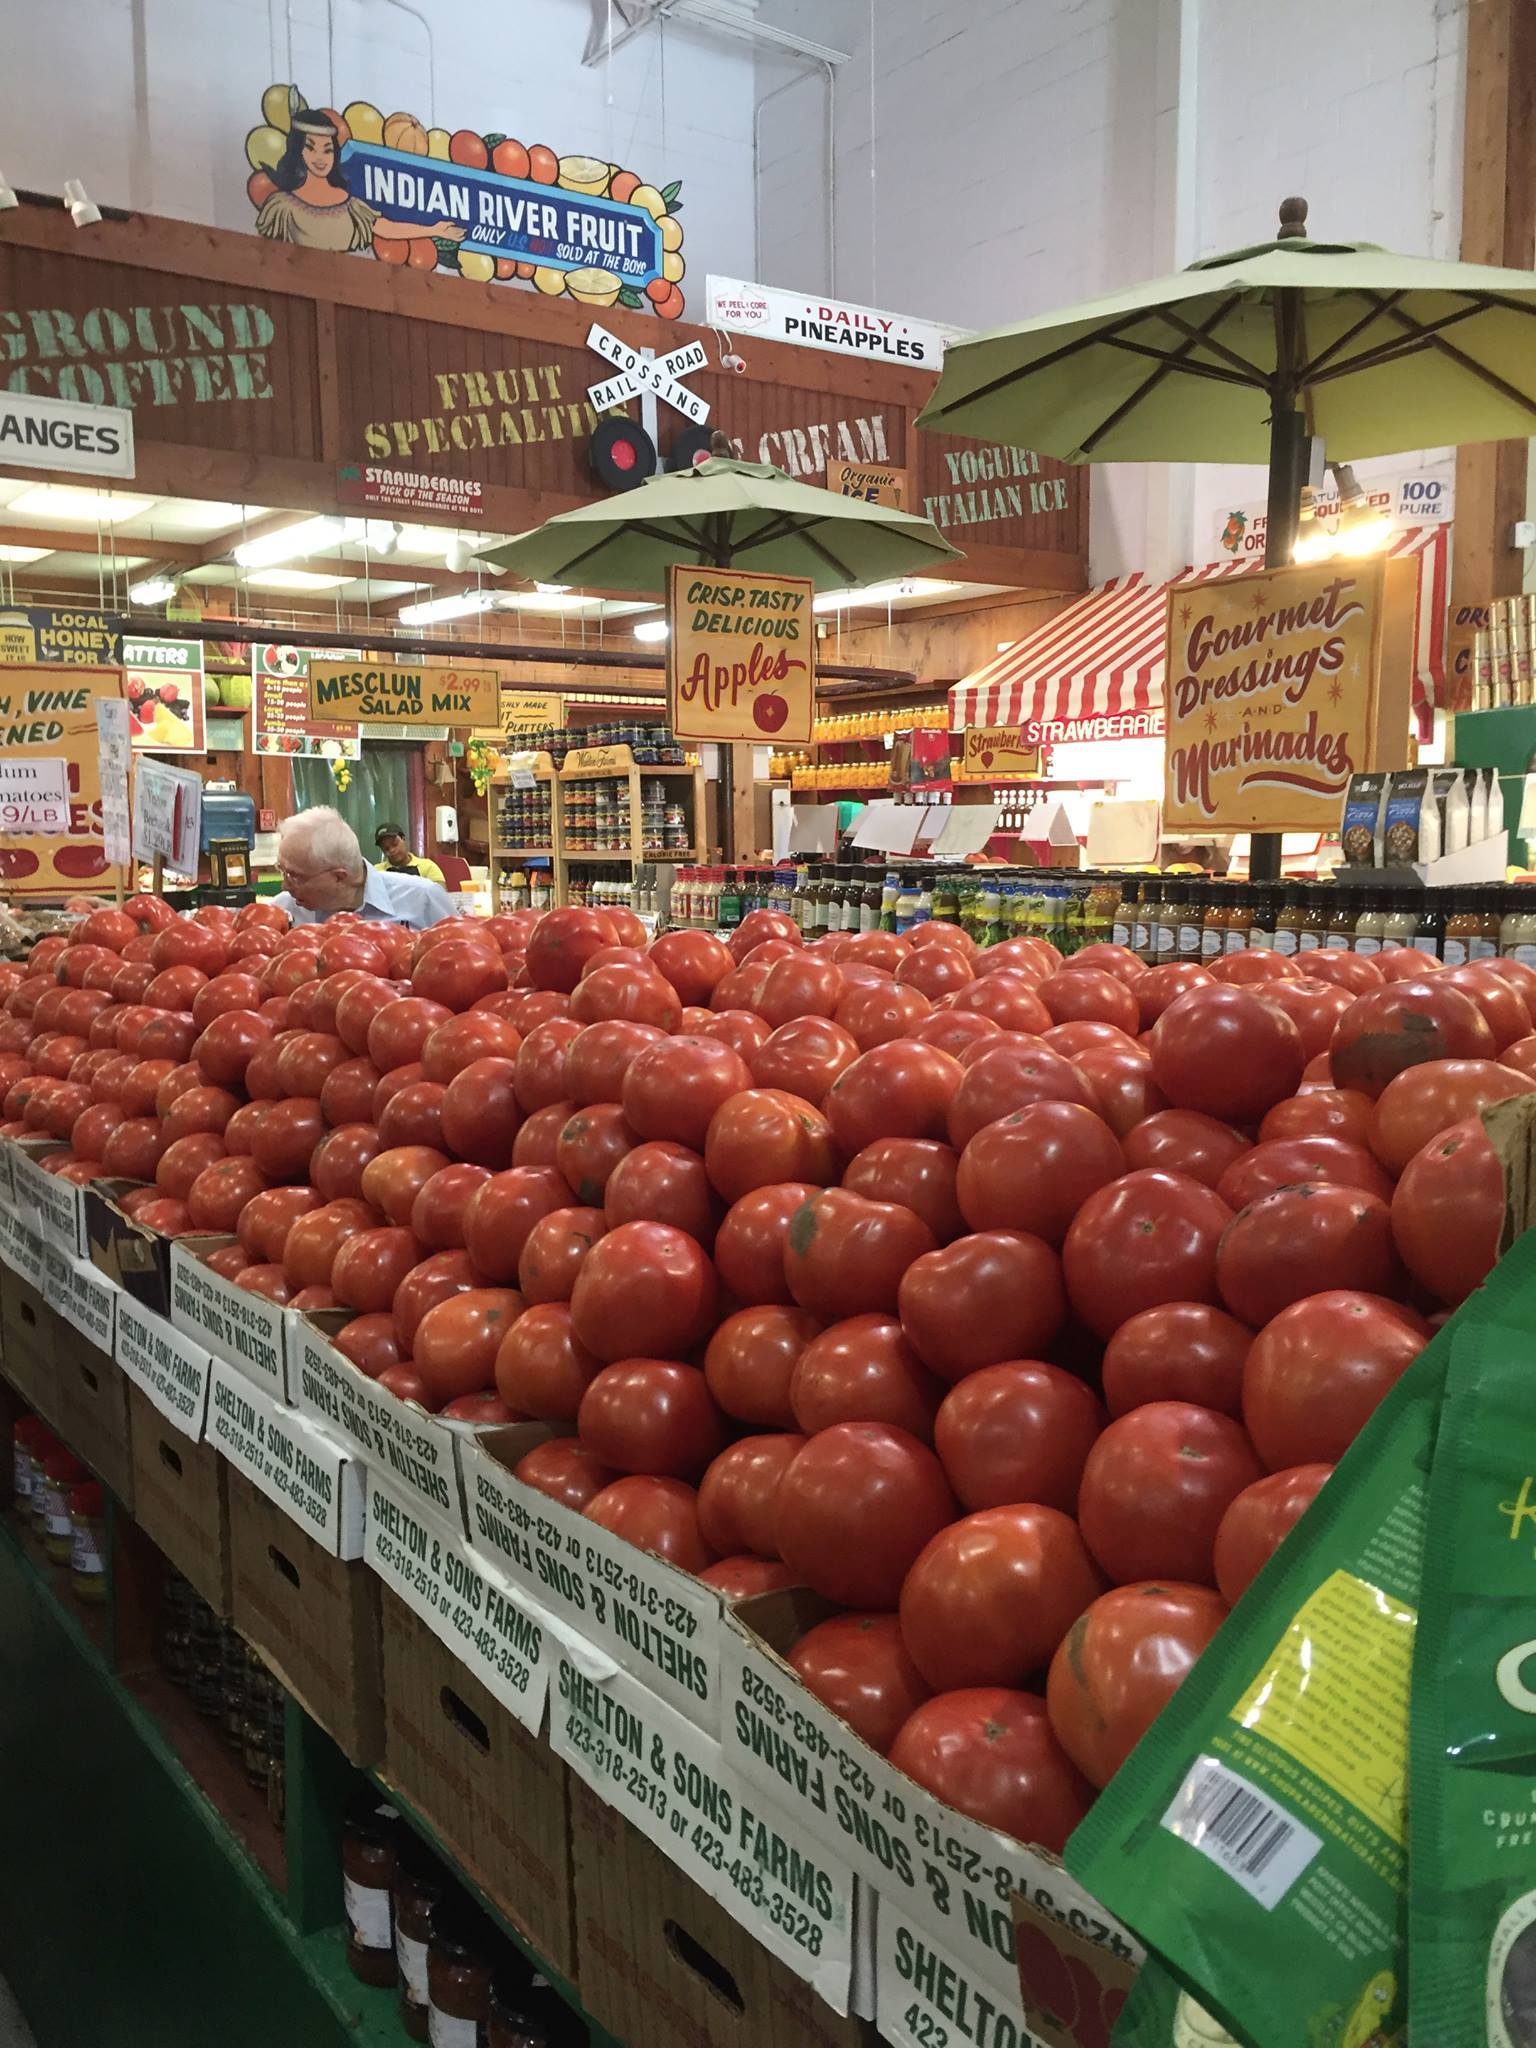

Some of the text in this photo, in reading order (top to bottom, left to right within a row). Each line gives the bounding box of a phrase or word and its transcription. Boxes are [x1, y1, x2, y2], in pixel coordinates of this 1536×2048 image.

[364, 164, 643, 257] INDIAN RIVER FRUIT
[471, 225, 506, 245] ONLY
[556, 243, 583, 259] SOLD
[584, 251, 600, 265] AT
[602, 254, 619, 270] THE
[622, 258, 647, 276] BOYS
[726, 310, 762, 319] FOR YOU
[729, 301, 745, 310] PEEL
[750, 301, 767, 311] CORE
[818, 306, 893, 334] DAILY
[0, 304, 274, 360] GROUND
[785, 316, 925, 361] PINEAPPLES
[597, 335, 701, 417] CROSSING
[665, 345, 704, 376] ROAD
[8, 352, 274, 409] COFFEE
[435, 364, 562, 412] FRUIT
[593, 376, 637, 407] RAIL
[0, 413, 121, 456] ANGES
[758, 414, 891, 478] CREAM
[365, 467, 482, 496] STRAWBERRIES
[840, 466, 896, 489] Organic
[944, 446, 1040, 485] YOGURT
[380, 484, 470, 505] PICK OF THE SEASON
[923, 478, 1068, 528] ITALIAN ICE
[1400, 502, 1443, 515] PURE
[749, 588, 805, 613] TASTY
[4, 633, 25, 644] HOW
[40, 628, 119, 650] HONEY
[51, 612, 108, 630] LOCAL
[691, 609, 800, 641] DELICIOUS
[1187, 577, 1365, 673] Gourmet
[0, 644, 30, 654] SWEET
[63, 649, 99, 665] FOR
[263, 691, 283, 699] Small
[281, 687, 302, 695] people
[316, 671, 480, 705] MESCLUN $2.99
[680, 642, 807, 712] Apples
[1175, 636, 1346, 719] Dressings
[26, 687, 91, 715] VINE
[285, 700, 306, 709] people
[358, 692, 472, 716] SALAD MIX
[523, 701, 548, 710] MADE
[285, 727, 306, 735] people
[505, 721, 555, 734] PLATTERS
[1027, 713, 1165, 742] STRAWBERRIE
[1171, 710, 1355, 815] Marinades
[174, 1283, 200, 1323] FARMS
[201, 1303, 223, 1340] SONS
[154, 1338, 172, 1372] SONS
[172, 1354, 201, 1397] FARMS
[235, 1326, 277, 1376] SHELTON
[214, 1380, 333, 1505] SHELTON & SONS FARMS
[302, 1368, 450, 1509] SHELTON & SONS FARMS
[216, 1415, 264, 1471] 423-318-2513
[273, 1468, 327, 1529] 423-483-3528
[565, 1535, 581, 1560] or
[372, 1490, 542, 1665] SHELTON & SONS FARMS
[586, 1546, 698, 1639] 423-318-2513
[376, 1533, 530, 1694] 423-318-2513 or 423-483-3528
[475, 1502, 708, 1701] SHELTON & SONS FARMS
[742, 1665, 876, 1801] 423-483-3528
[558, 1659, 833, 1922] SHELTON & SONS FARMS
[734, 1700, 951, 1916] & SONS FARMS
[882, 1795, 906, 1824] or
[566, 1715, 824, 1958] 423-318-2513 or 423-483-3528
